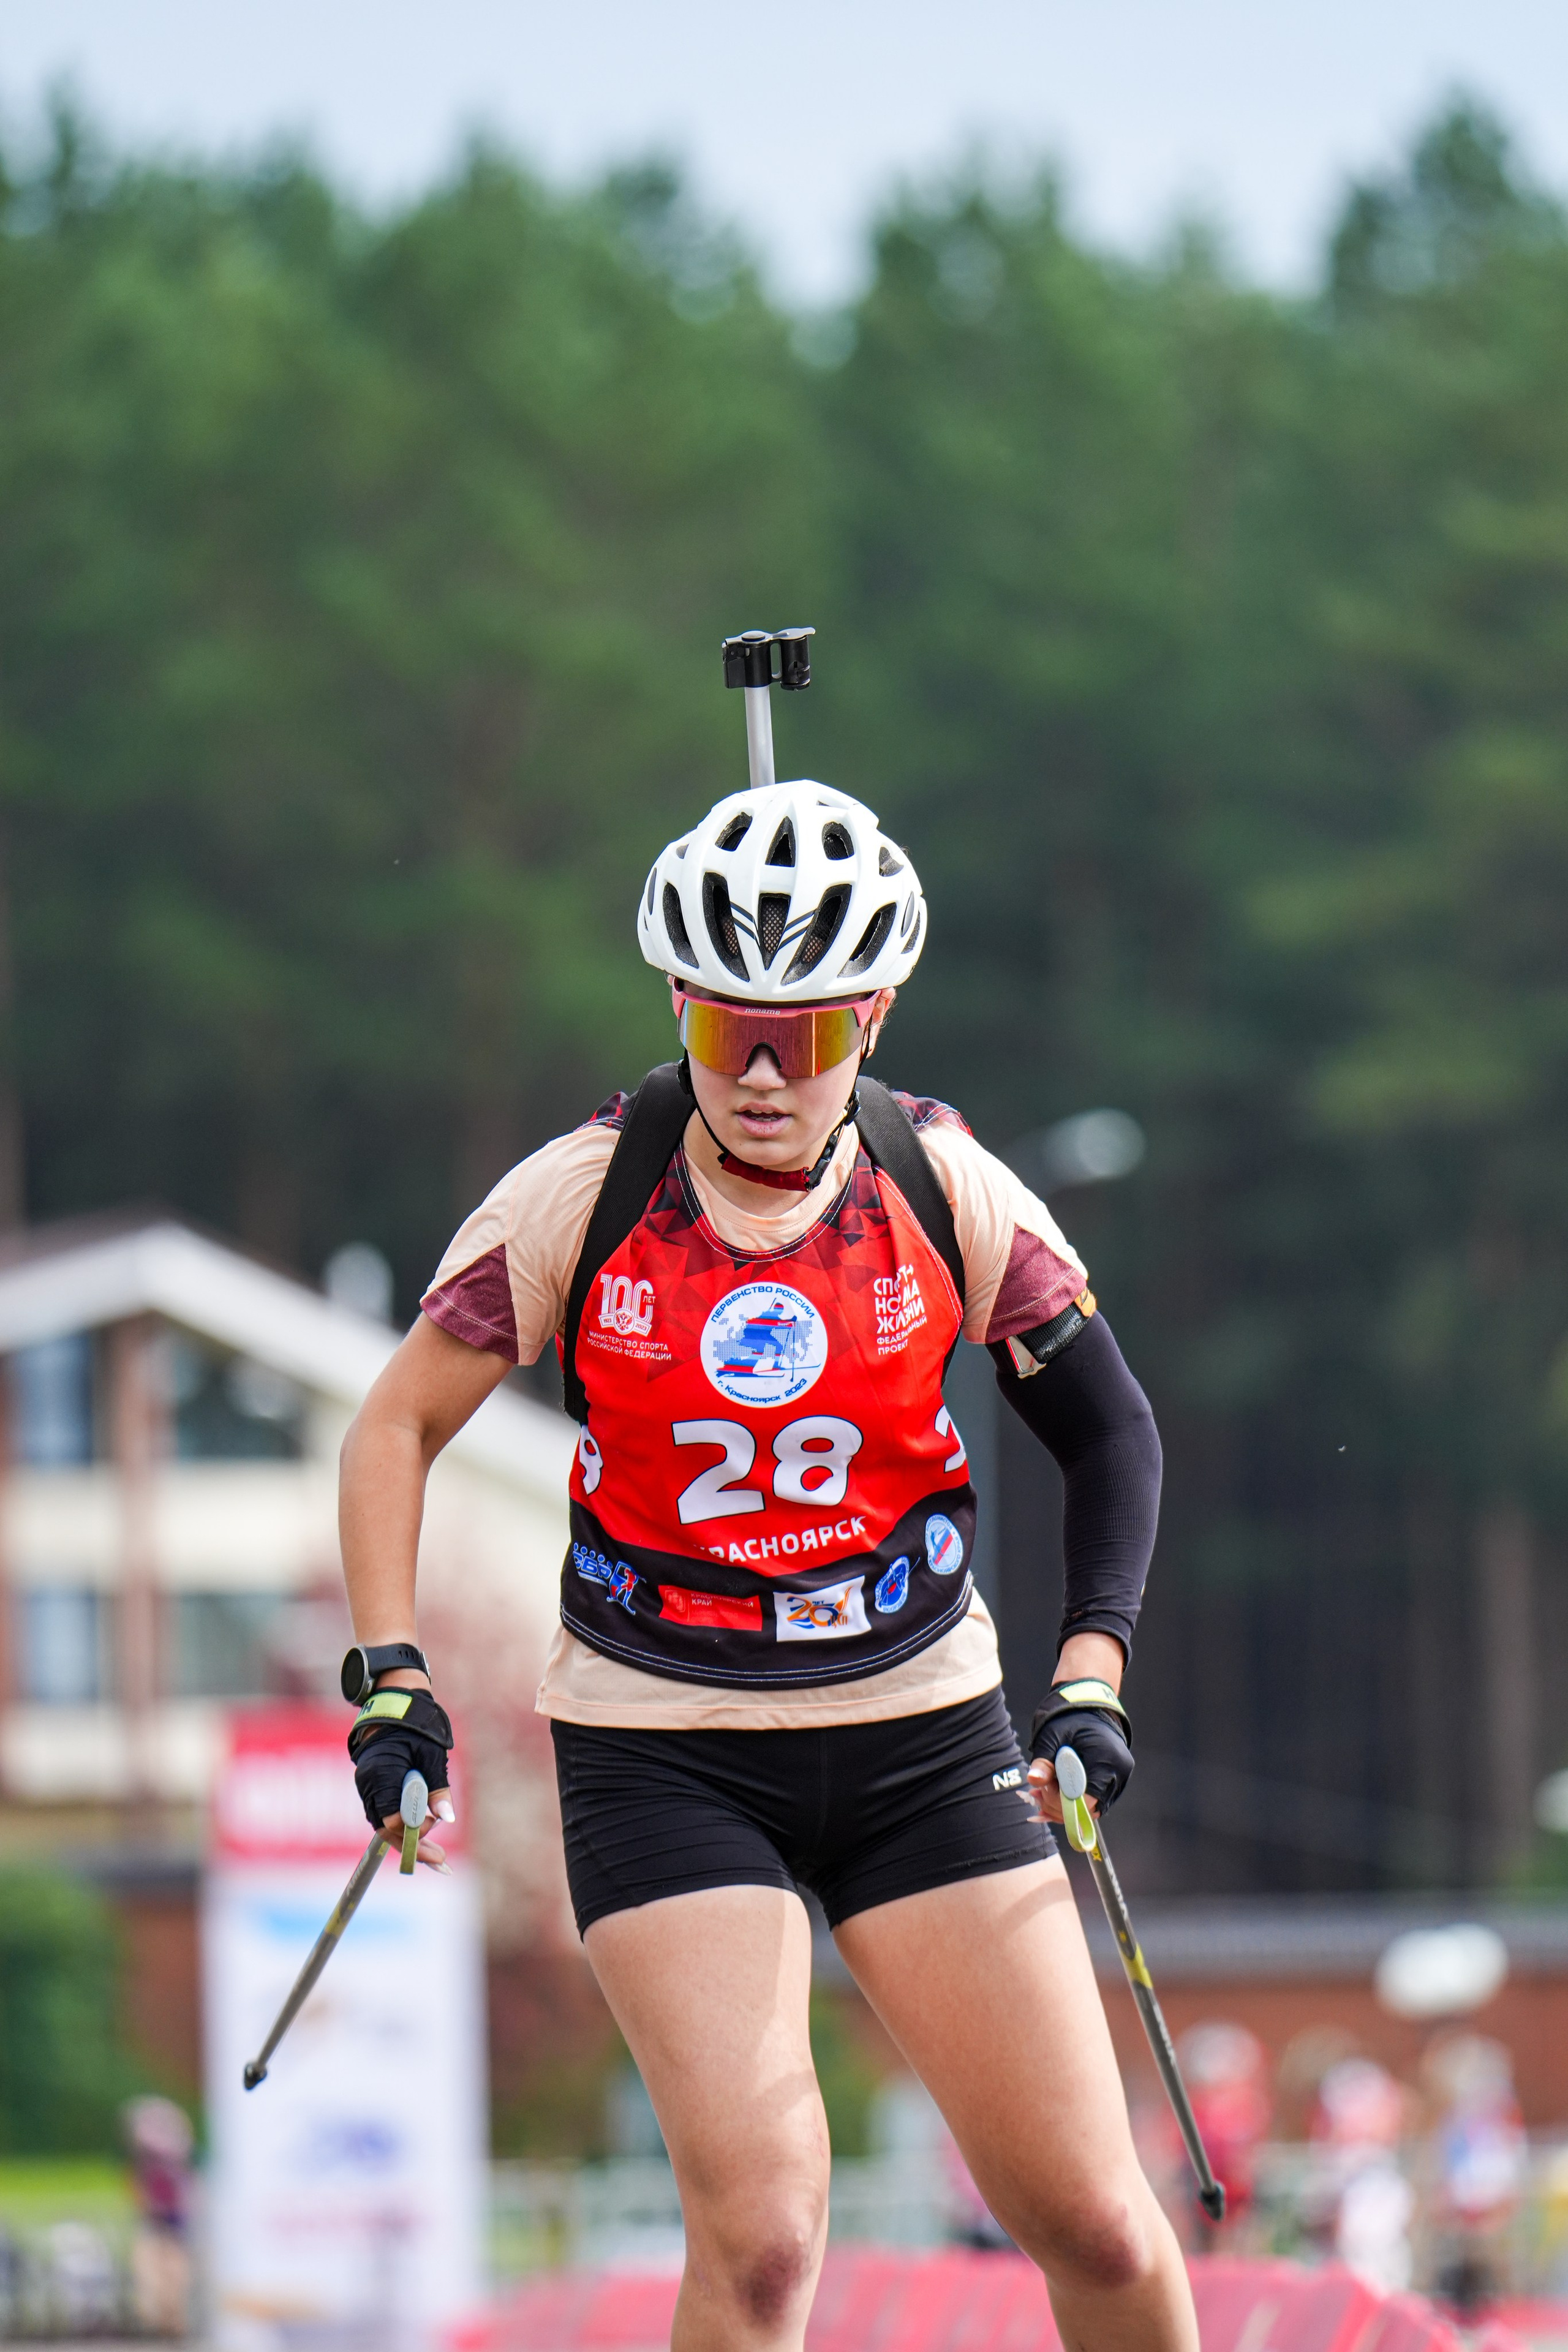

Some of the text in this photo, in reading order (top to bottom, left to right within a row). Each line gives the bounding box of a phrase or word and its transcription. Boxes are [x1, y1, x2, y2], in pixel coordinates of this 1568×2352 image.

[711, 1286, 815, 1322] ПЕРВЕНСТВО РОССИИ
[876, 1297, 925, 1334] ЖИЗНИ
[587, 1337, 671, 1360] РОССИЙСКОЙ ФЕДЕРАЦИИ
[589, 1330, 669, 1351] МИНИСТЕРСТВО СПОРТА
[878, 1339, 908, 1355] ПРОЕКТ
[725, 1385, 781, 1403] Красноярск
[785, 1378, 807, 1397] 2023
[671, 1415, 864, 1525] 28
[693, 1515, 867, 1563] РАСНОЯРСК
